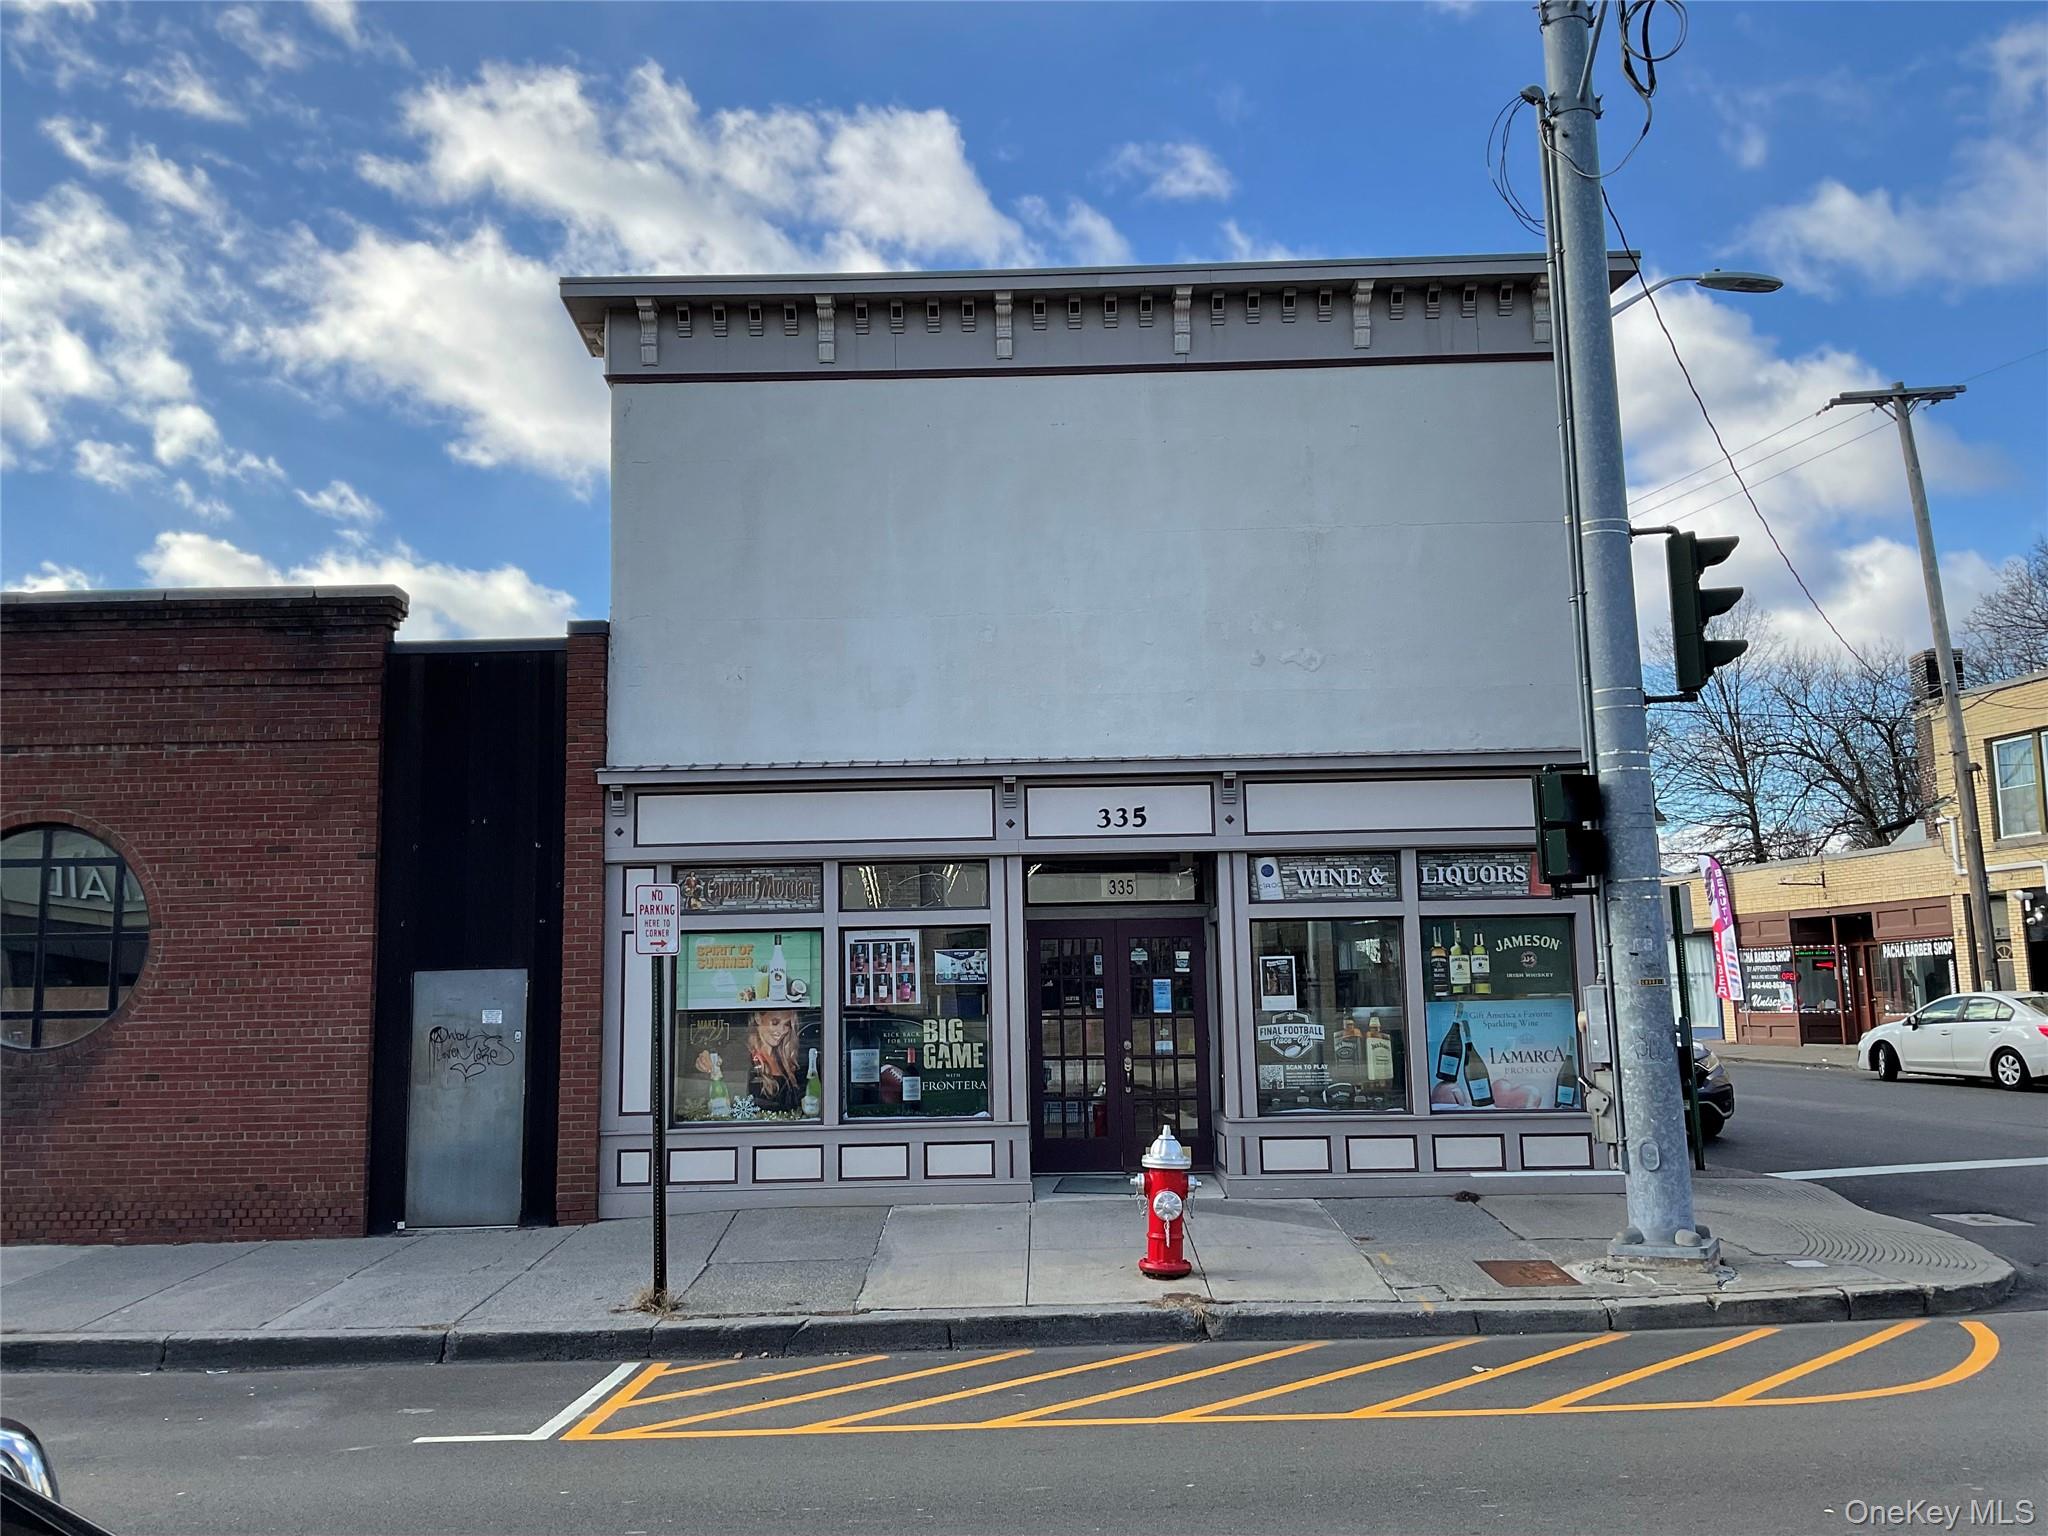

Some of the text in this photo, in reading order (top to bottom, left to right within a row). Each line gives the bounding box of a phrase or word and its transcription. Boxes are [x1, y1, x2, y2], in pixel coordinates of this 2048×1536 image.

[1096, 806, 1148, 829] 335
[1296, 867, 1387, 887] WINE &
[1420, 865, 1528, 887] LIQUORS
[703, 874, 816, 905] Captain Morgan
[1108, 879, 1134, 895] 335
[651, 890, 663, 902] NO
[1714, 868, 1729, 926] BEAUTY
[639, 904, 676, 916] PARKING
[644, 919, 671, 928] HERE TO
[645, 929, 670, 938] CORNER
[697, 943, 755, 957] SPIRIT OF
[1495, 934, 1560, 952] JAMESON
[1905, 942, 1933, 957] BARBER
[1934, 940, 1953, 956] SHOP
[697, 956, 755, 970] SUMMER
[1753, 950, 1776, 963] BARBER
[1776, 949, 1791, 962] SHOP
[1752, 964, 1781, 973] APPOINTMENT
[1781, 972, 1797, 981] OPE
[1469, 1010, 1553, 1019] Gift America's Favorite
[697, 1019, 716, 1029] MAKE
[923, 1018, 964, 1043] BIG
[1260, 1024, 1323, 1036] FINAL FOOTBALL
[1483, 1020, 1518, 1030] Sparkling
[923, 1042, 985, 1070] GAME
[1504, 1066, 1558, 1075] PROSECCO
[922, 1079, 988, 1091] FRONTERA
